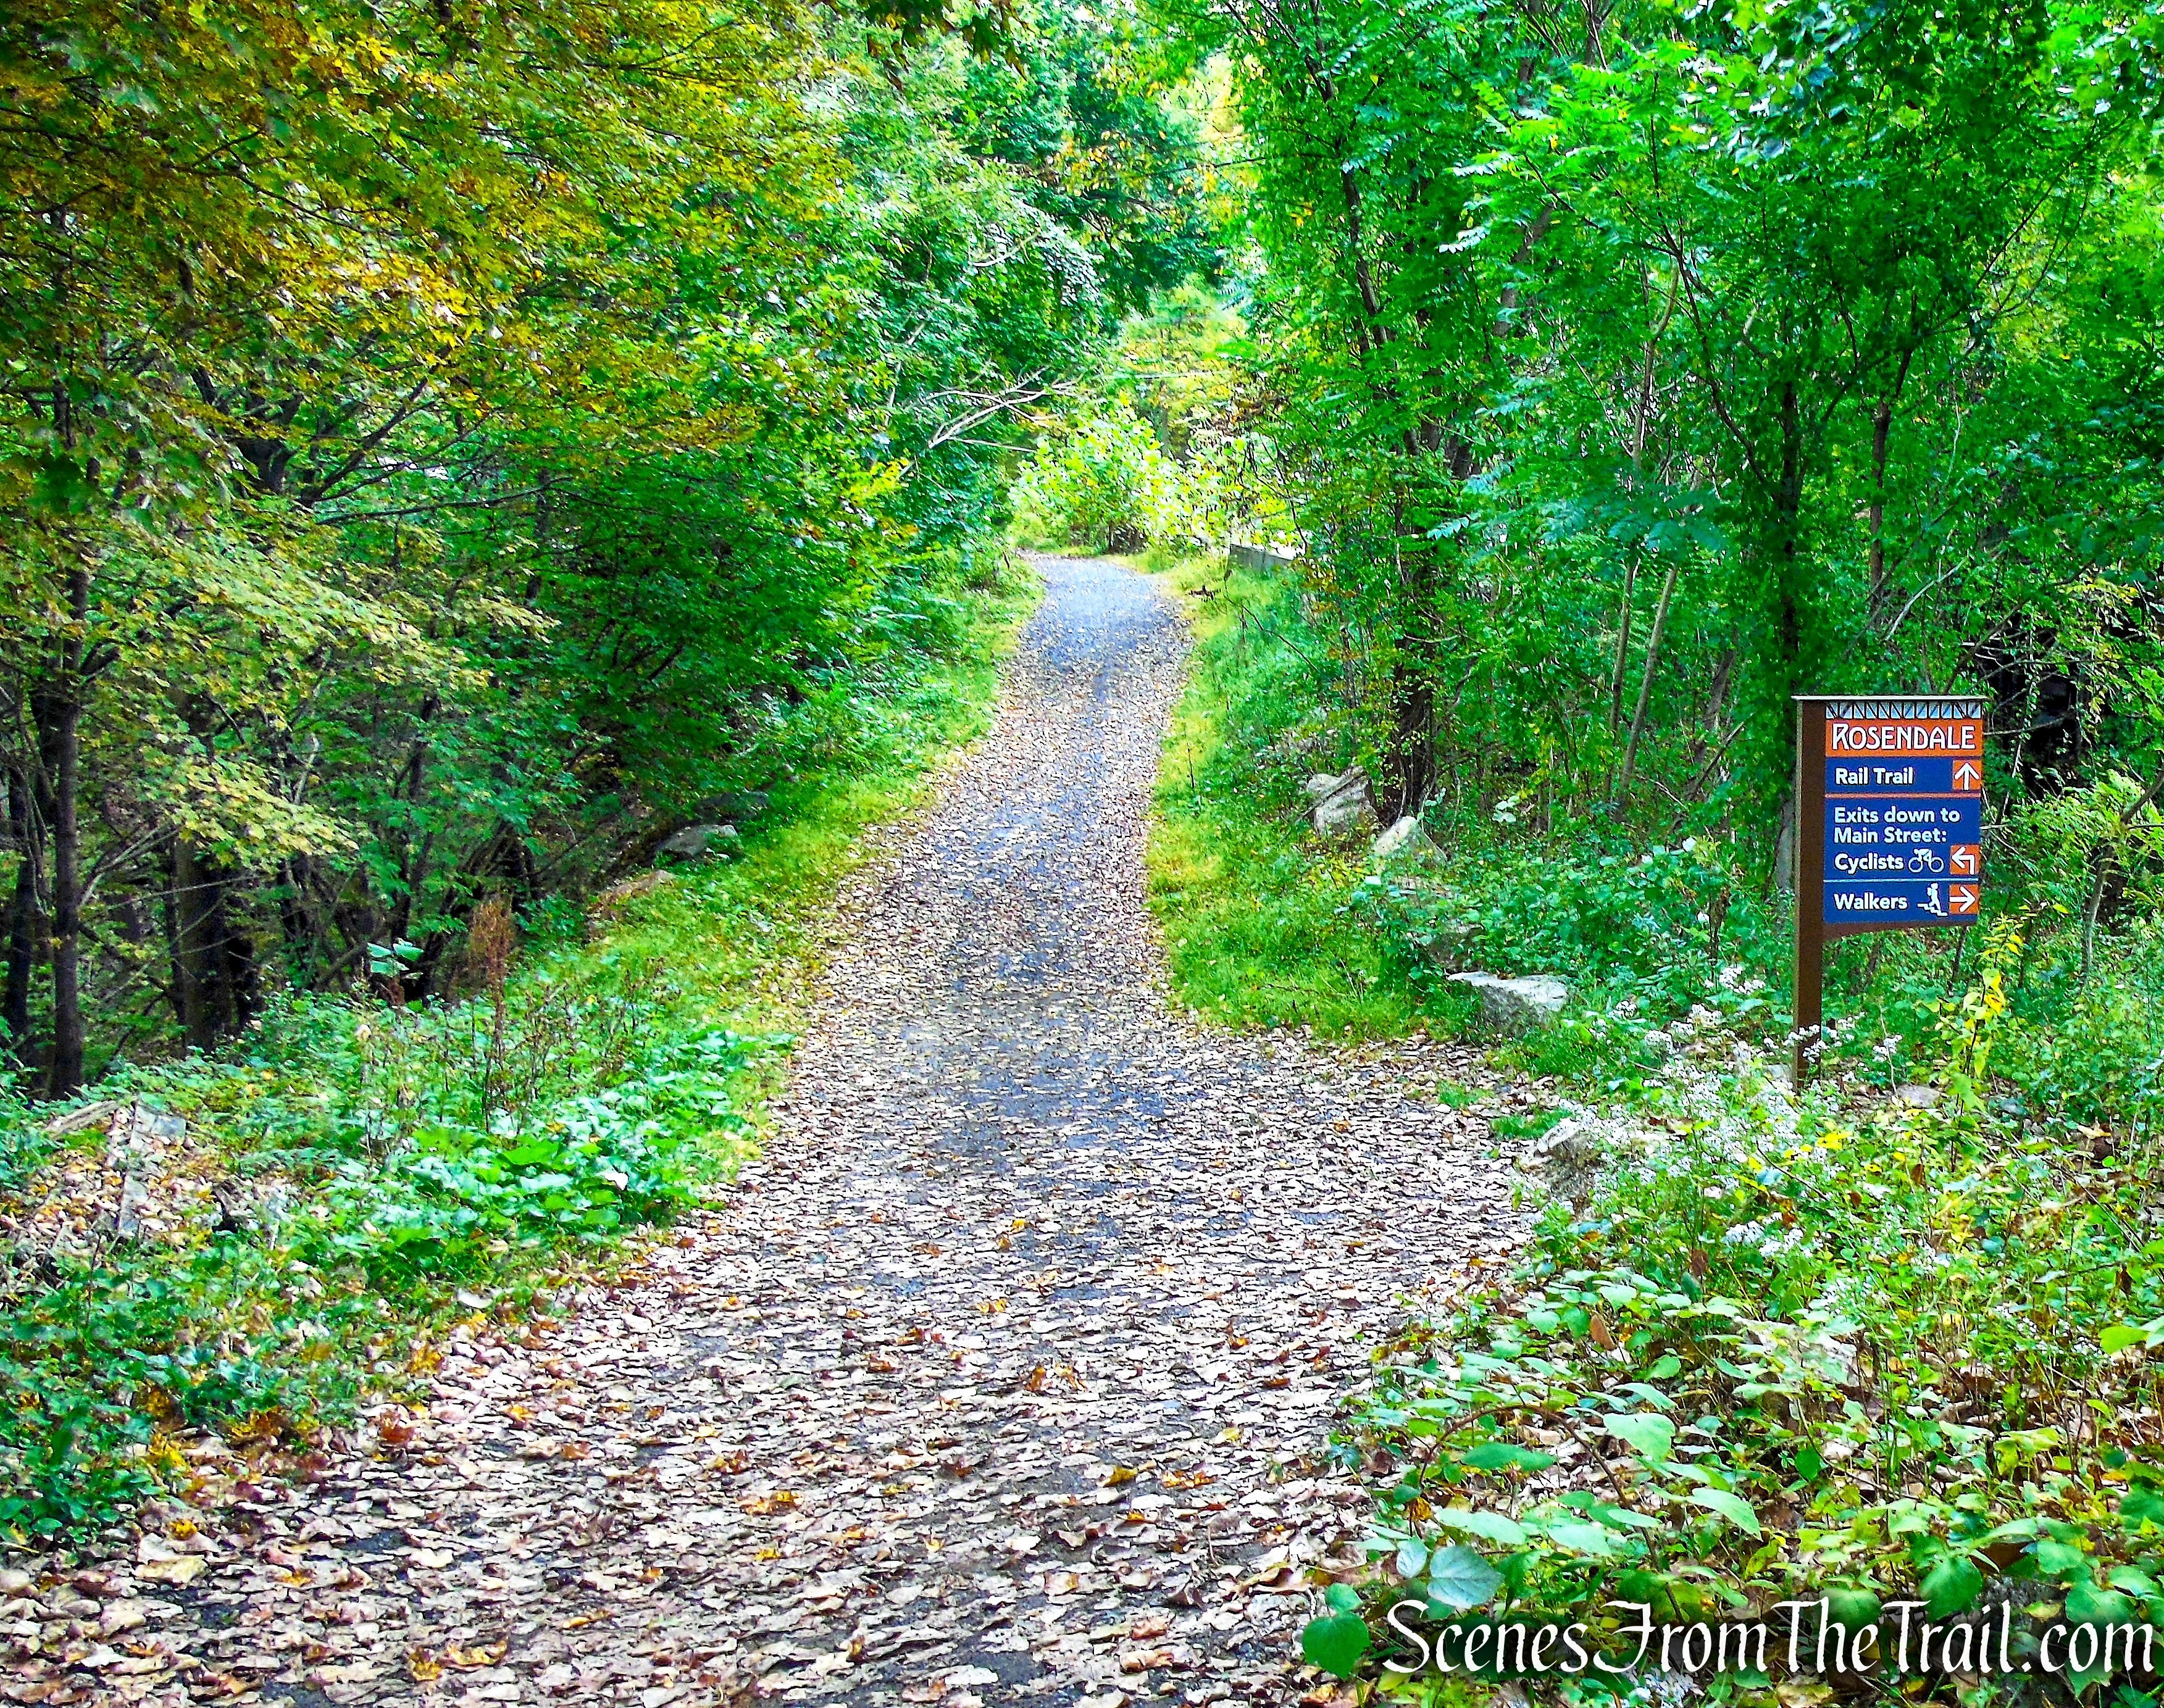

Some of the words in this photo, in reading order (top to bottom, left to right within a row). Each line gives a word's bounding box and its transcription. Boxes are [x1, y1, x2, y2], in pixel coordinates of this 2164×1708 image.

[1832, 723, 1975, 750] ROSENDALE
[1835, 767, 1868, 785] Rail
[1873, 767, 1913, 785] Trail
[1834, 807, 1879, 823] Exits
[1884, 806, 1935, 822] down
[1940, 807, 1961, 822] to
[1834, 827, 1878, 843] Main
[1884, 827, 1947, 843] Street:
[1834, 852, 1904, 874] Cyclists
[1834, 893, 1907, 910] Walkers
